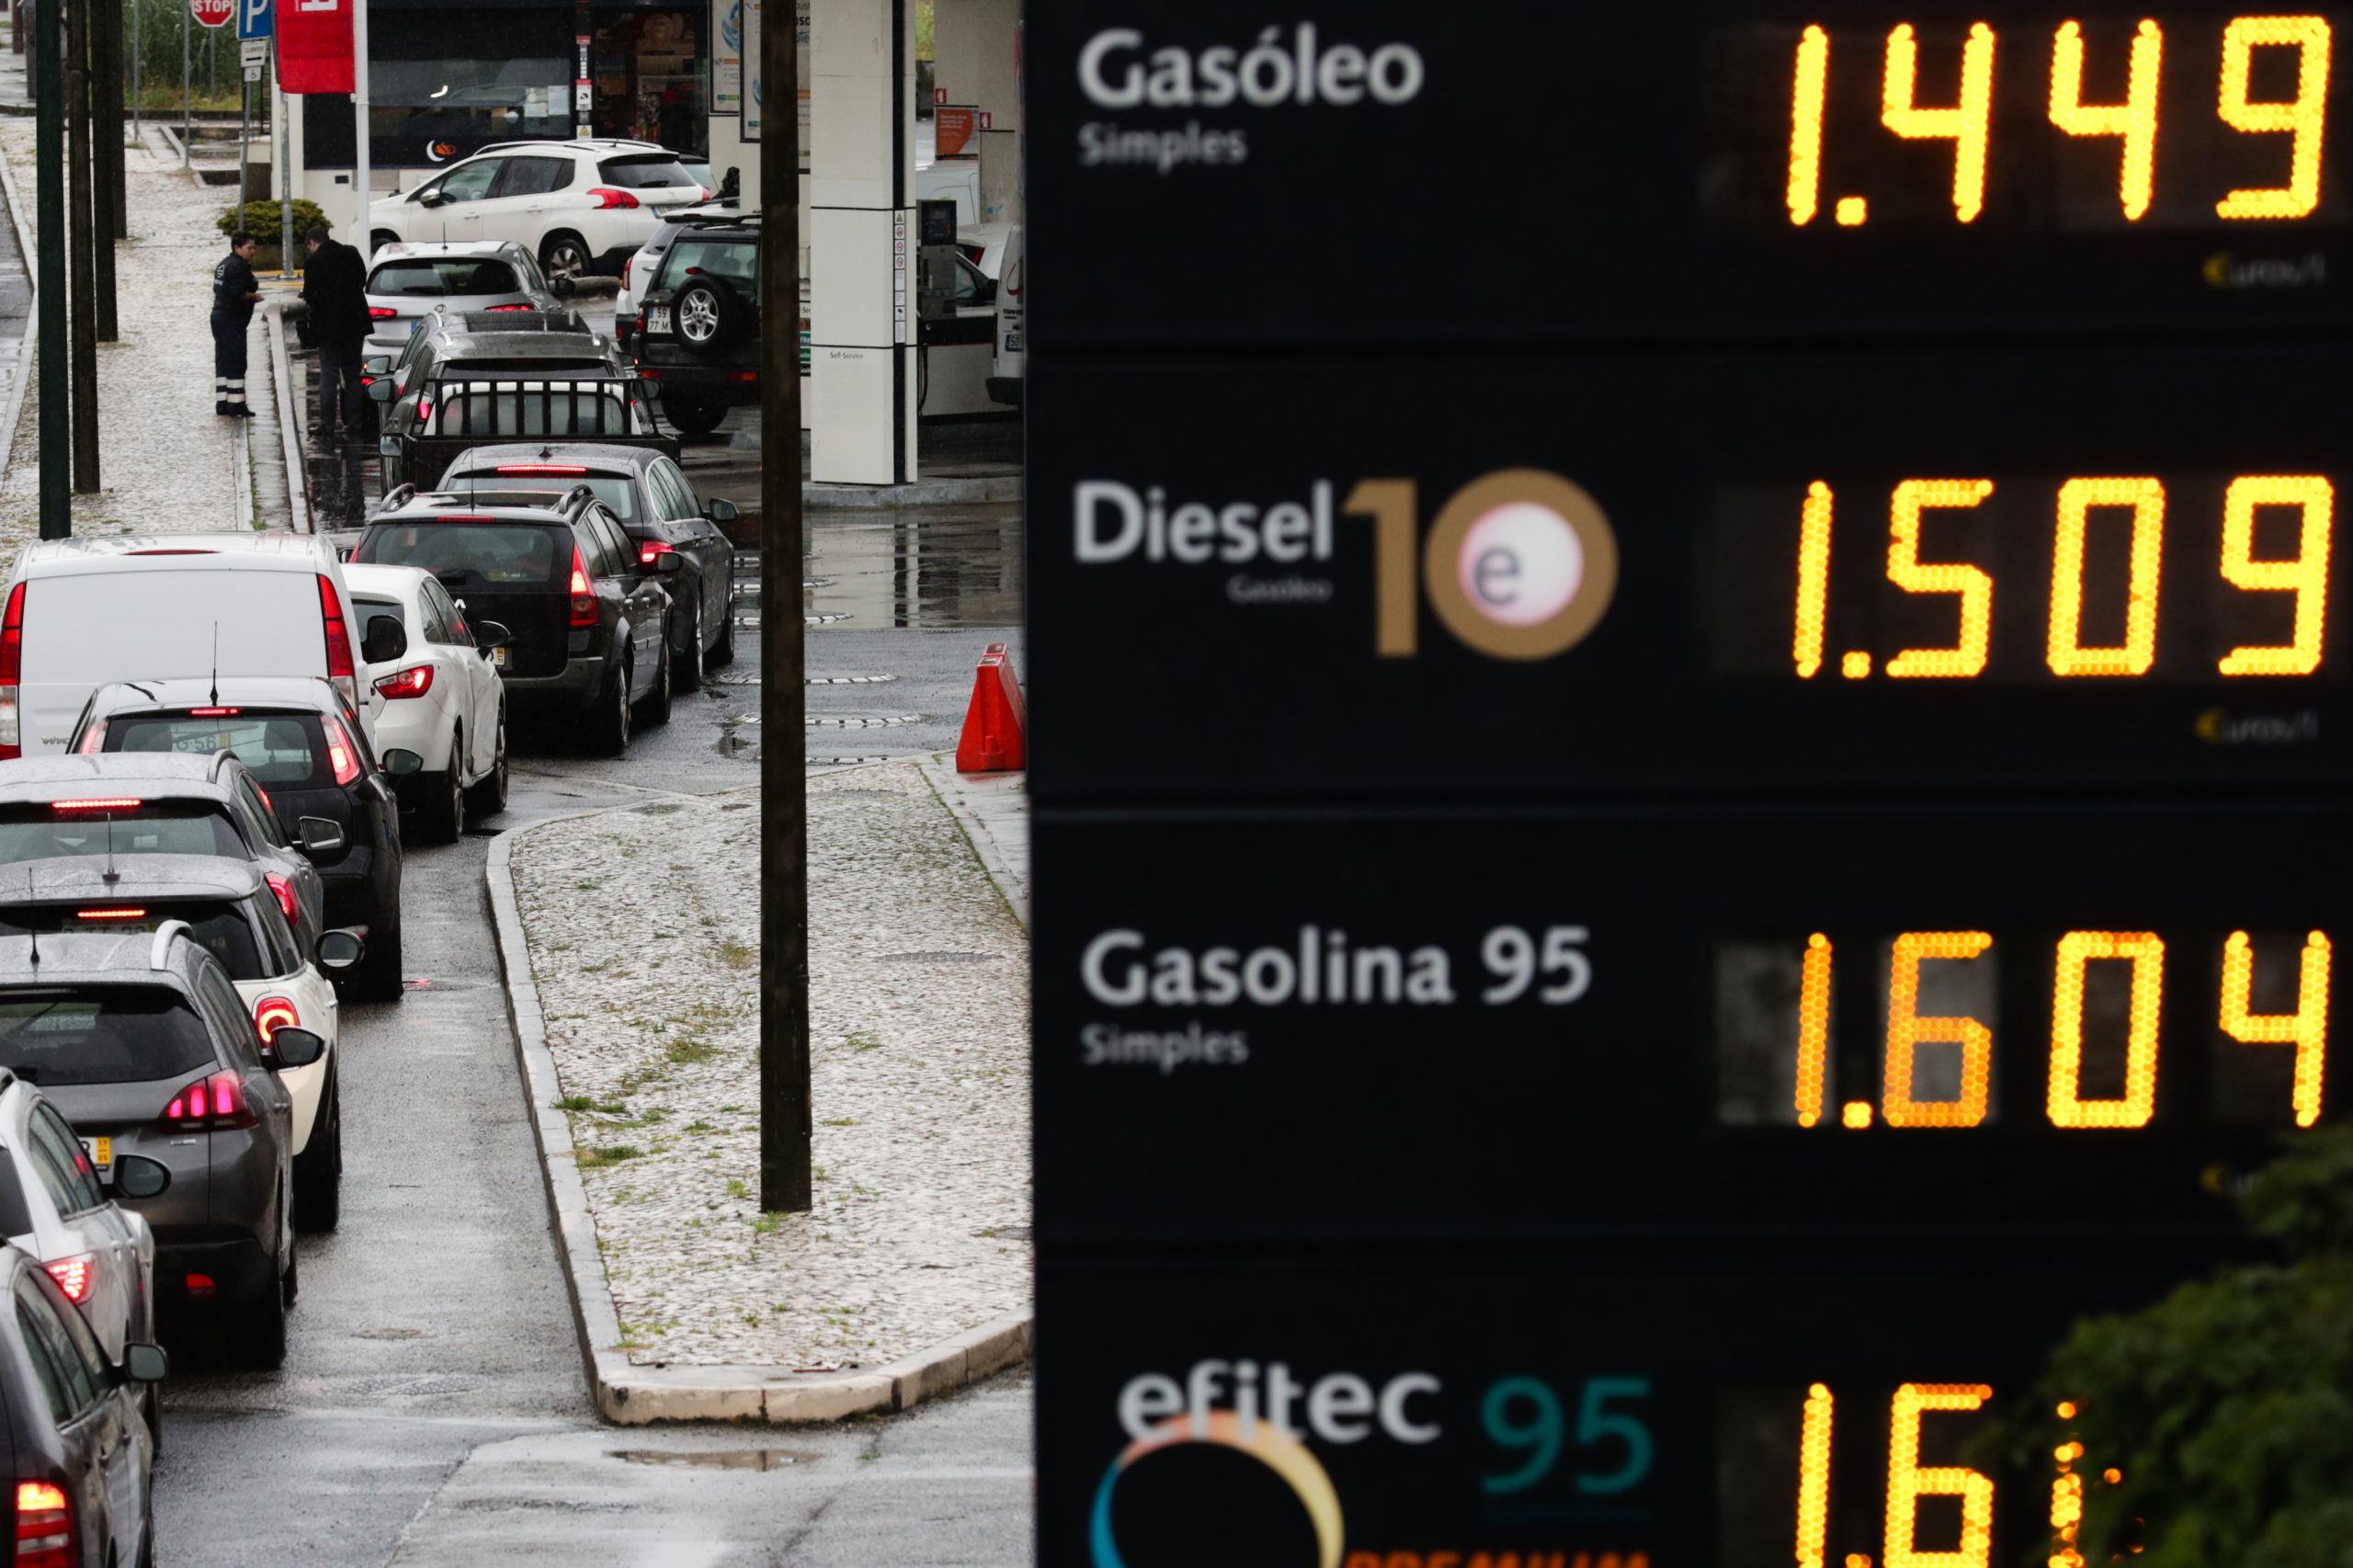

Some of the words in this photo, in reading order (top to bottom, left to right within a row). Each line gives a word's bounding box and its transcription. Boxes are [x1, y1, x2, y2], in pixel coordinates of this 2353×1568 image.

[194, 0, 230, 13] STOP
[246, 0, 267, 33] P
[1077, 20, 1426, 109] Gasóleo
[1078, 121, 1248, 175] Simples
[1783, 14, 2335, 227] 1.449
[1074, 478, 1334, 563] Diesel
[1792, 473, 2336, 680] 1.509
[1080, 925, 1455, 1006] Gasolina
[1481, 925, 1592, 1005] 95
[1081, 1022, 1250, 1074] Simples
[1792, 929, 2334, 1130] 1.604
[1118, 1360, 1442, 1445] efitec
[1482, 1375, 1653, 1493] 95
